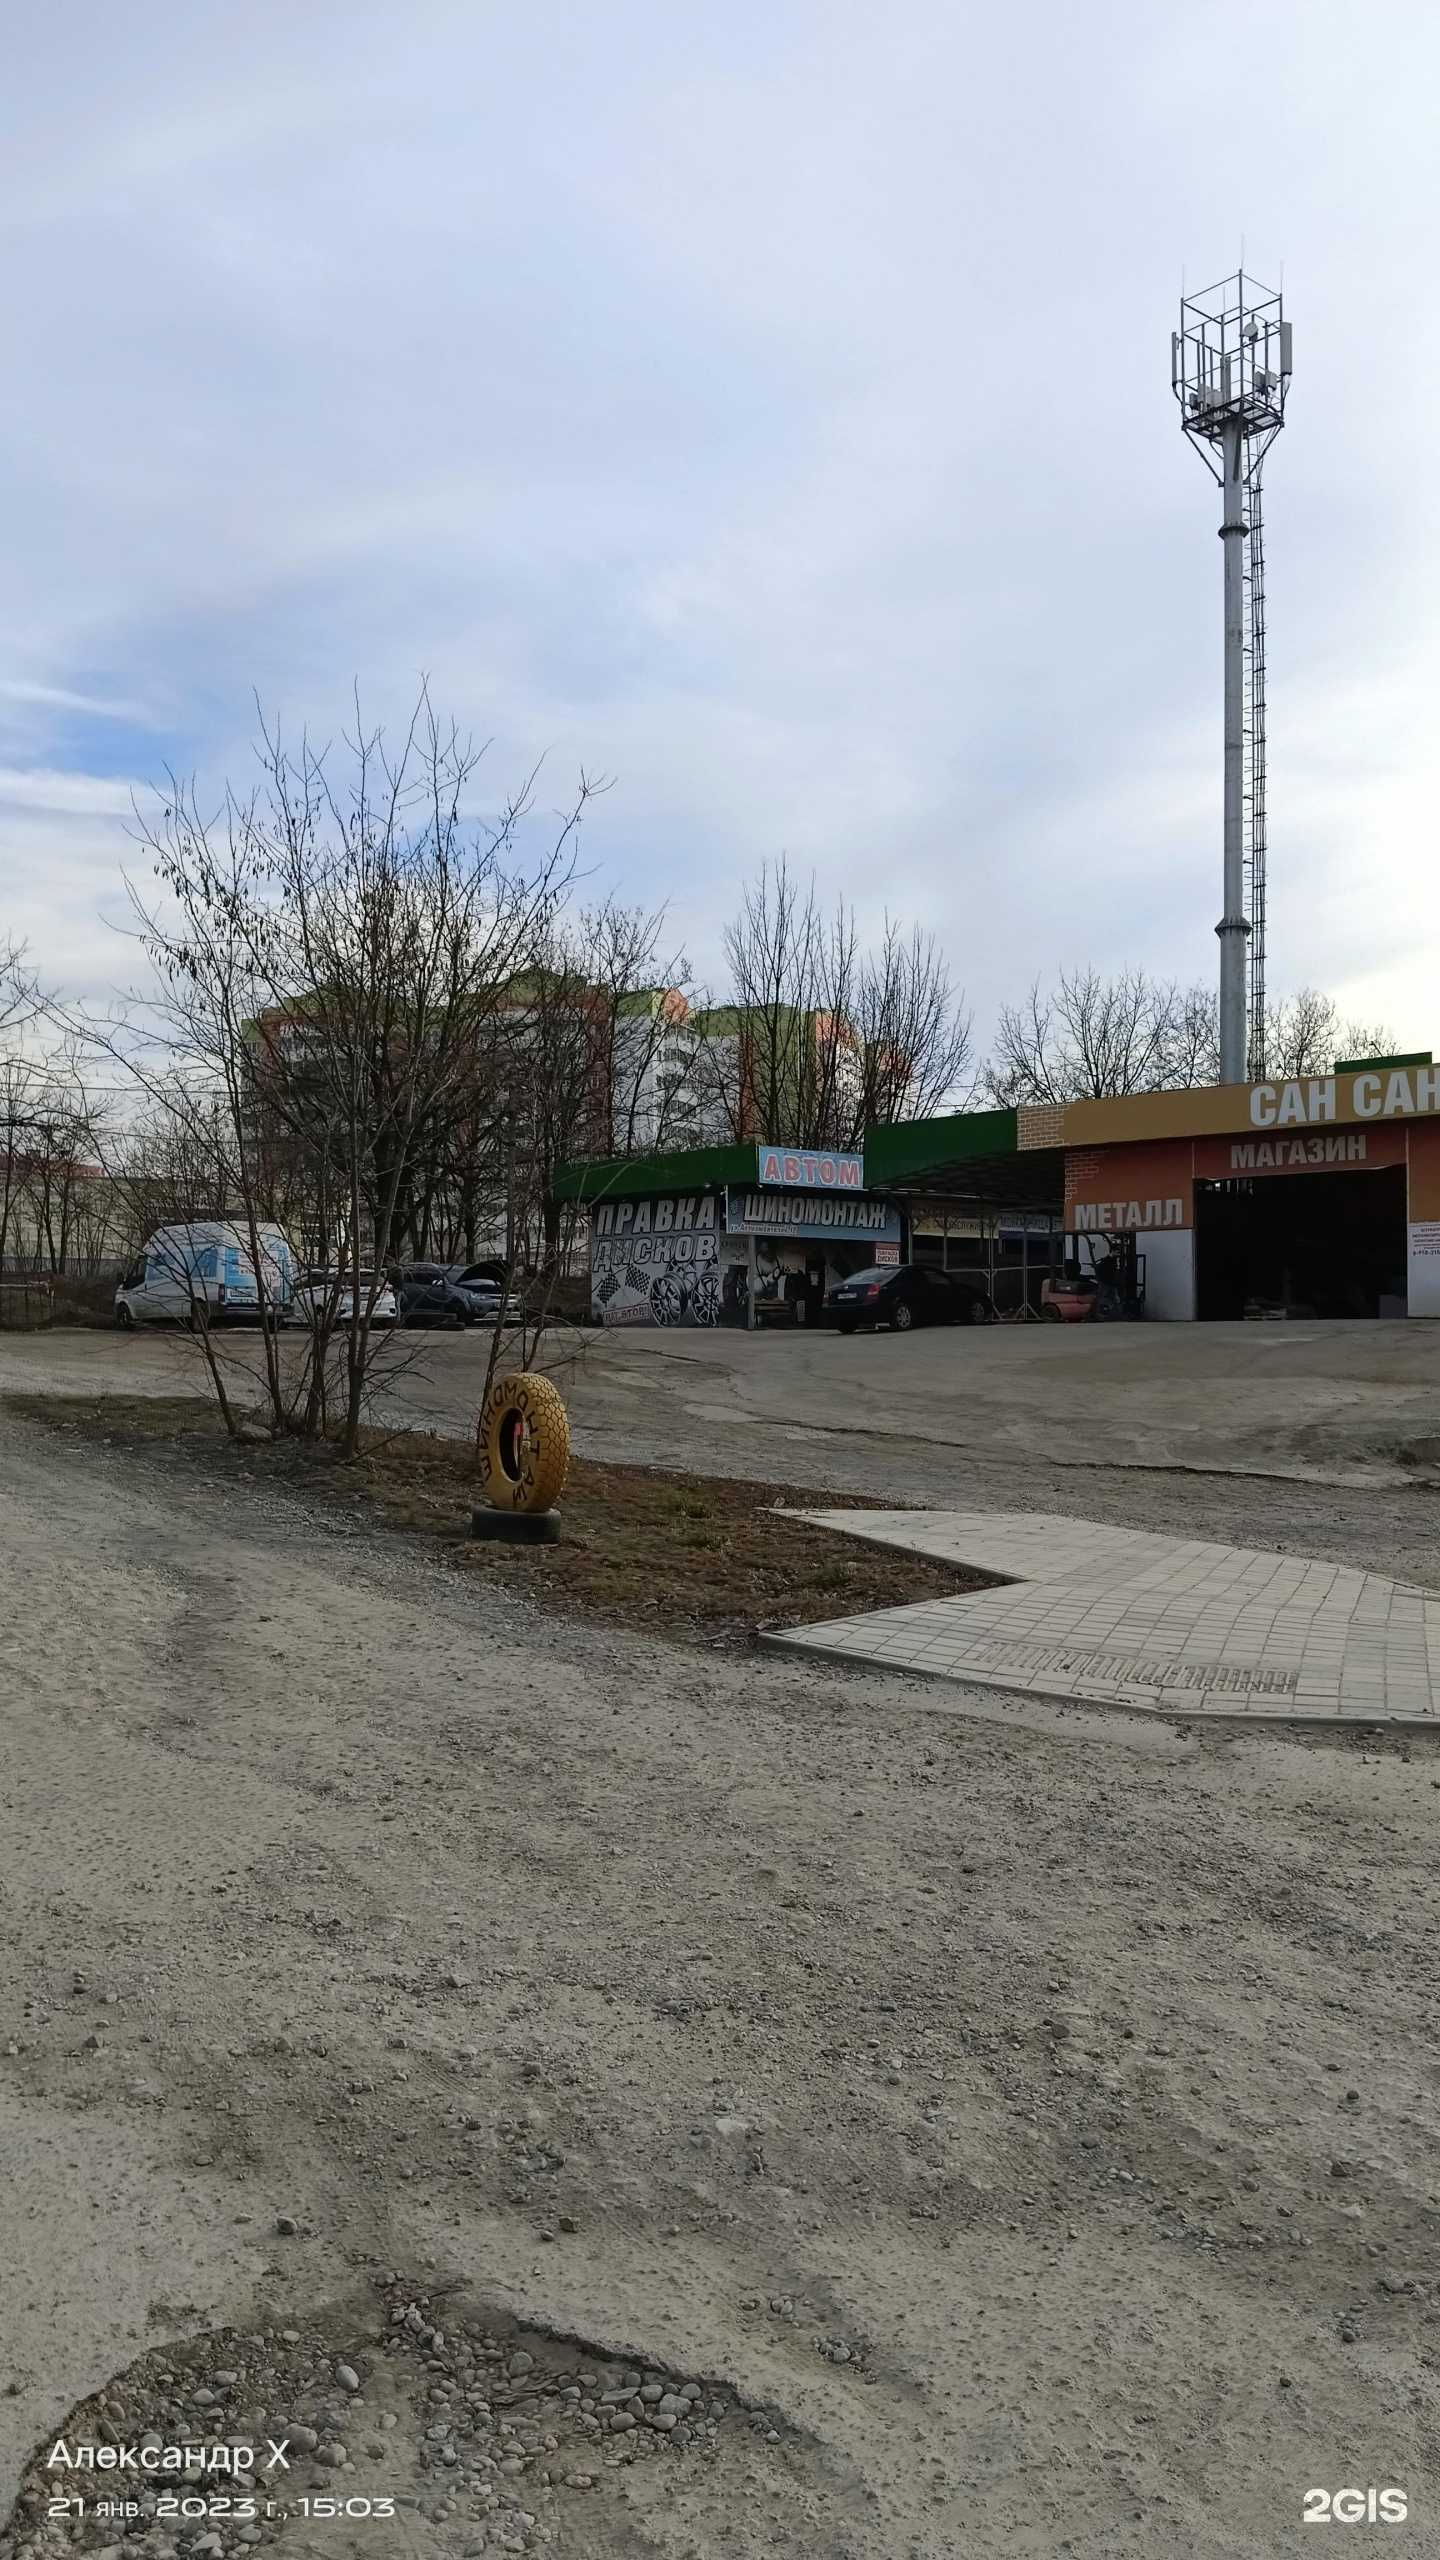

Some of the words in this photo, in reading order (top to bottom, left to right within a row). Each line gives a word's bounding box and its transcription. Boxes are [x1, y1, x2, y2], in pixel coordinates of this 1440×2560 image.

[1249, 1078, 1337, 1127] САН
[1230, 1134, 1368, 1169] МАГАЗИН
[764, 1154, 860, 1186] АВТОМ
[596, 1196, 716, 1237] ПРАВКА
[743, 1194, 887, 1229] ШИНОМОНТАЖ
[1074, 1199, 1184, 1230] МЕТАЛЛ
[592, 1234, 717, 1273] ДИСКОВ
